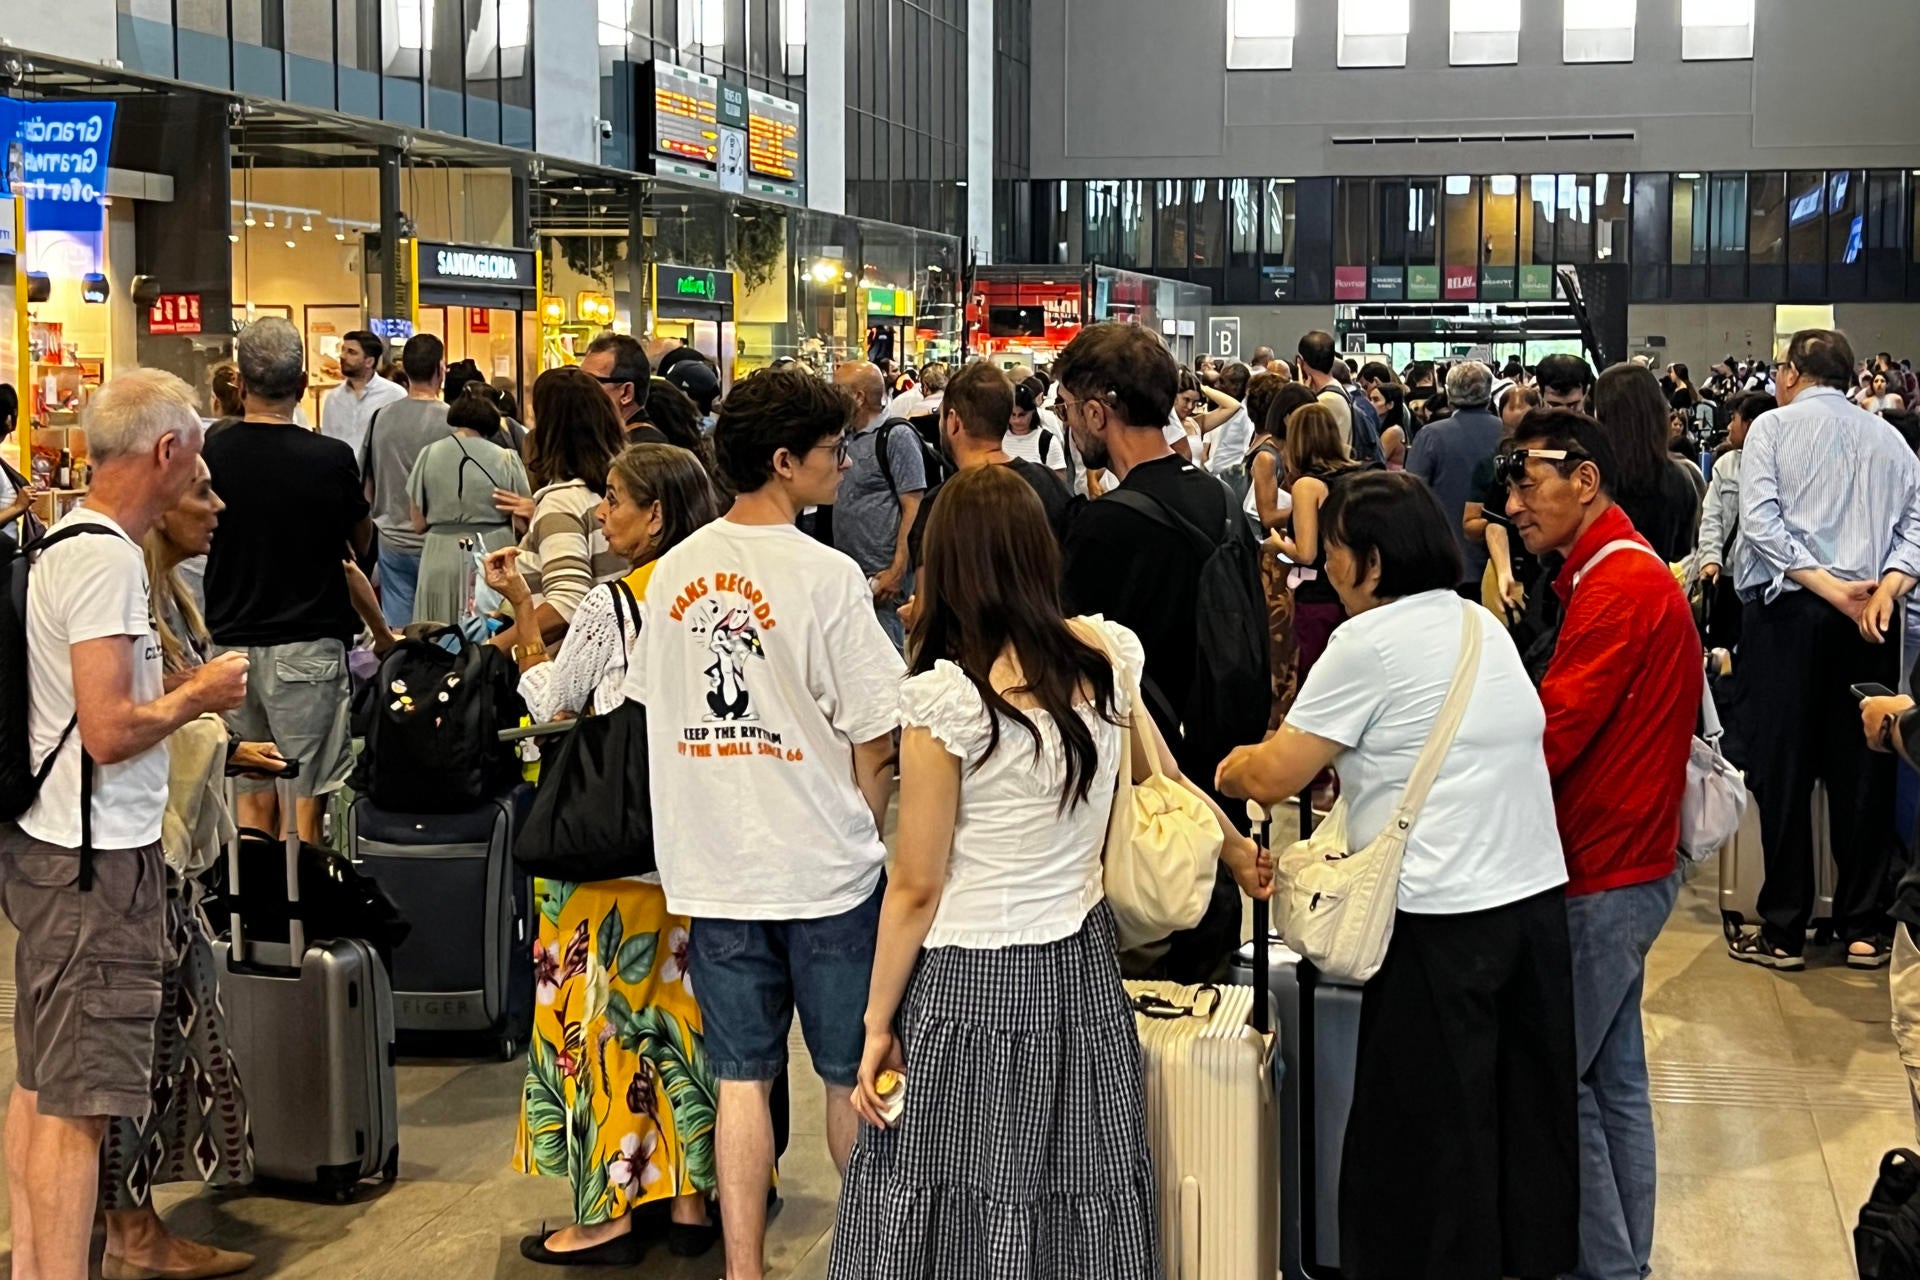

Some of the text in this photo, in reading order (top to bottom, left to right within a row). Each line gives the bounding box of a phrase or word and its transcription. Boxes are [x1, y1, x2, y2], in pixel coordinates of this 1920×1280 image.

[1447, 276, 1473, 289] RELAY
[1220, 330, 1232, 355] B
[670, 572, 776, 631] VANS RECORDS
[714, 726, 736, 739] THE
[690, 743, 712, 757] THE
[717, 741, 752, 757] WALL
[786, 747, 803, 761] 66
